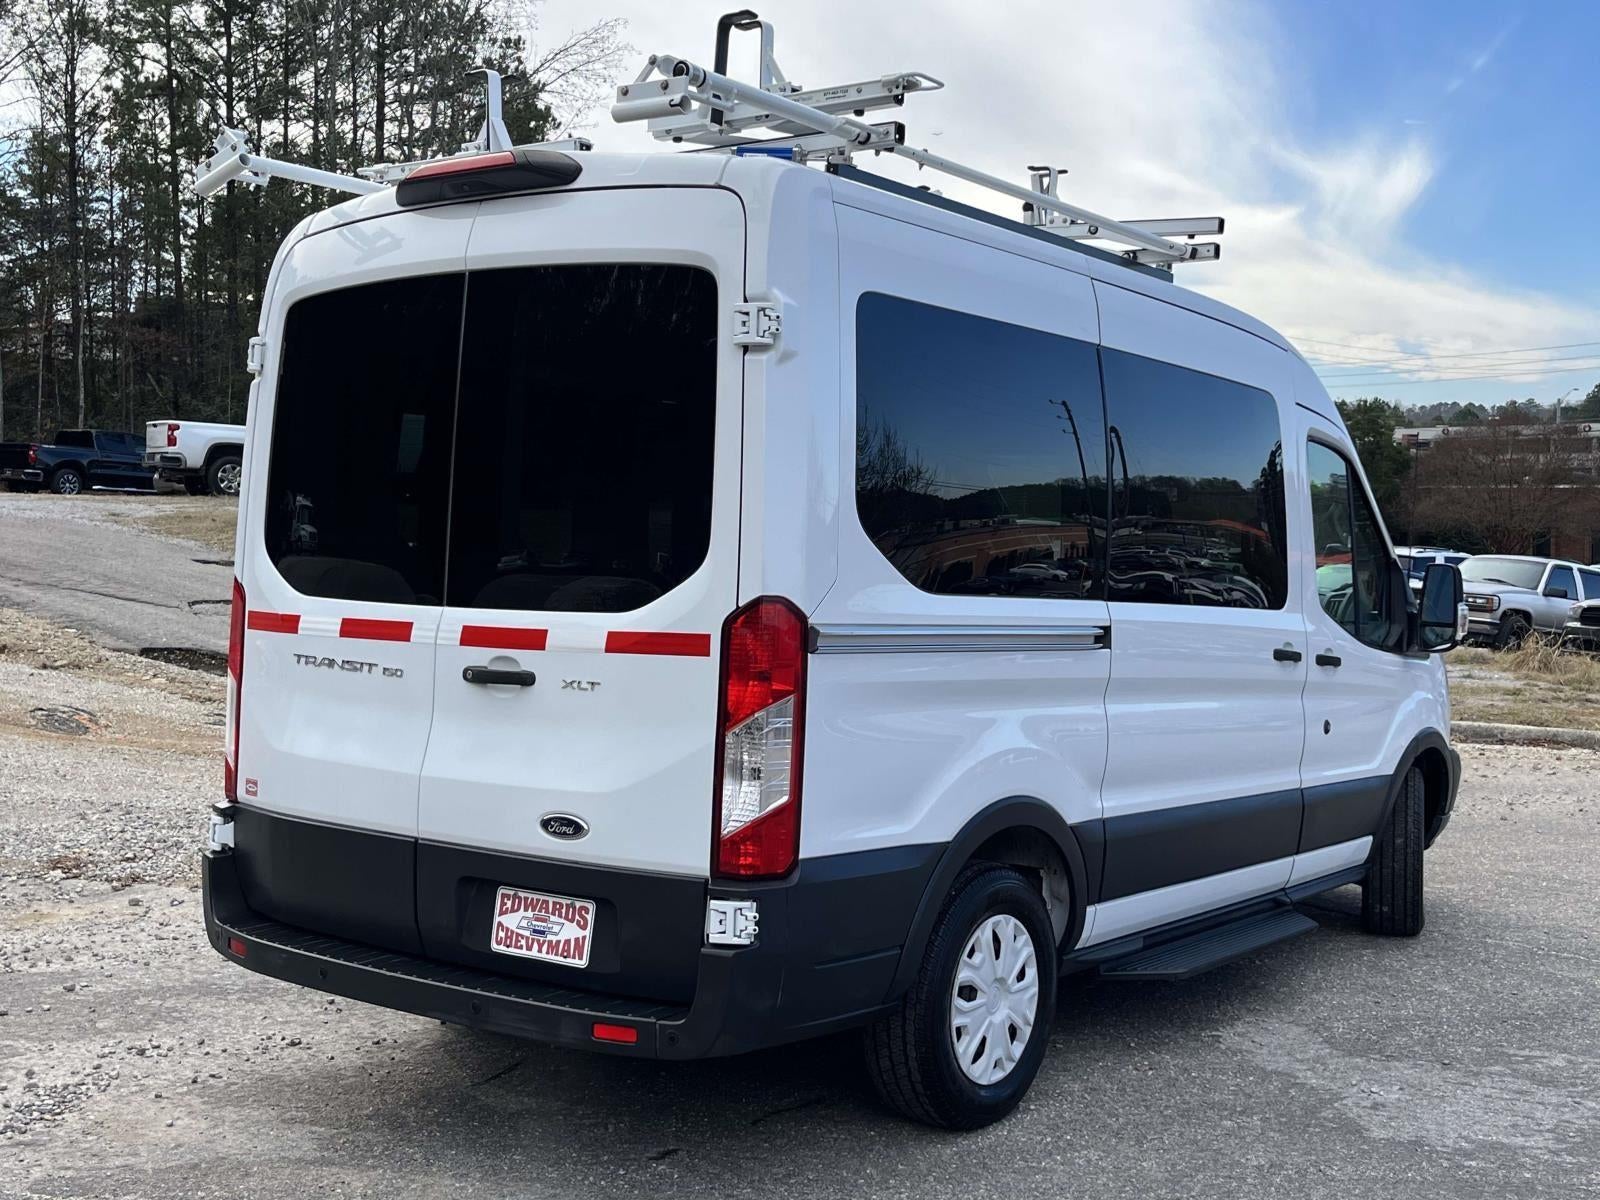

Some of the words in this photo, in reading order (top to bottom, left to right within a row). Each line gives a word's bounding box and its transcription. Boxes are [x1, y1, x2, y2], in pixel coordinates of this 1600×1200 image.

[293, 653, 379, 674] TRANSIT
[560, 679, 601, 692] XLT
[547, 820, 575, 834] Ford
[498, 892, 590, 931] EDWARDS
[526, 920, 554, 931] Chevrolet
[494, 920, 587, 961] CHEVYMAN
